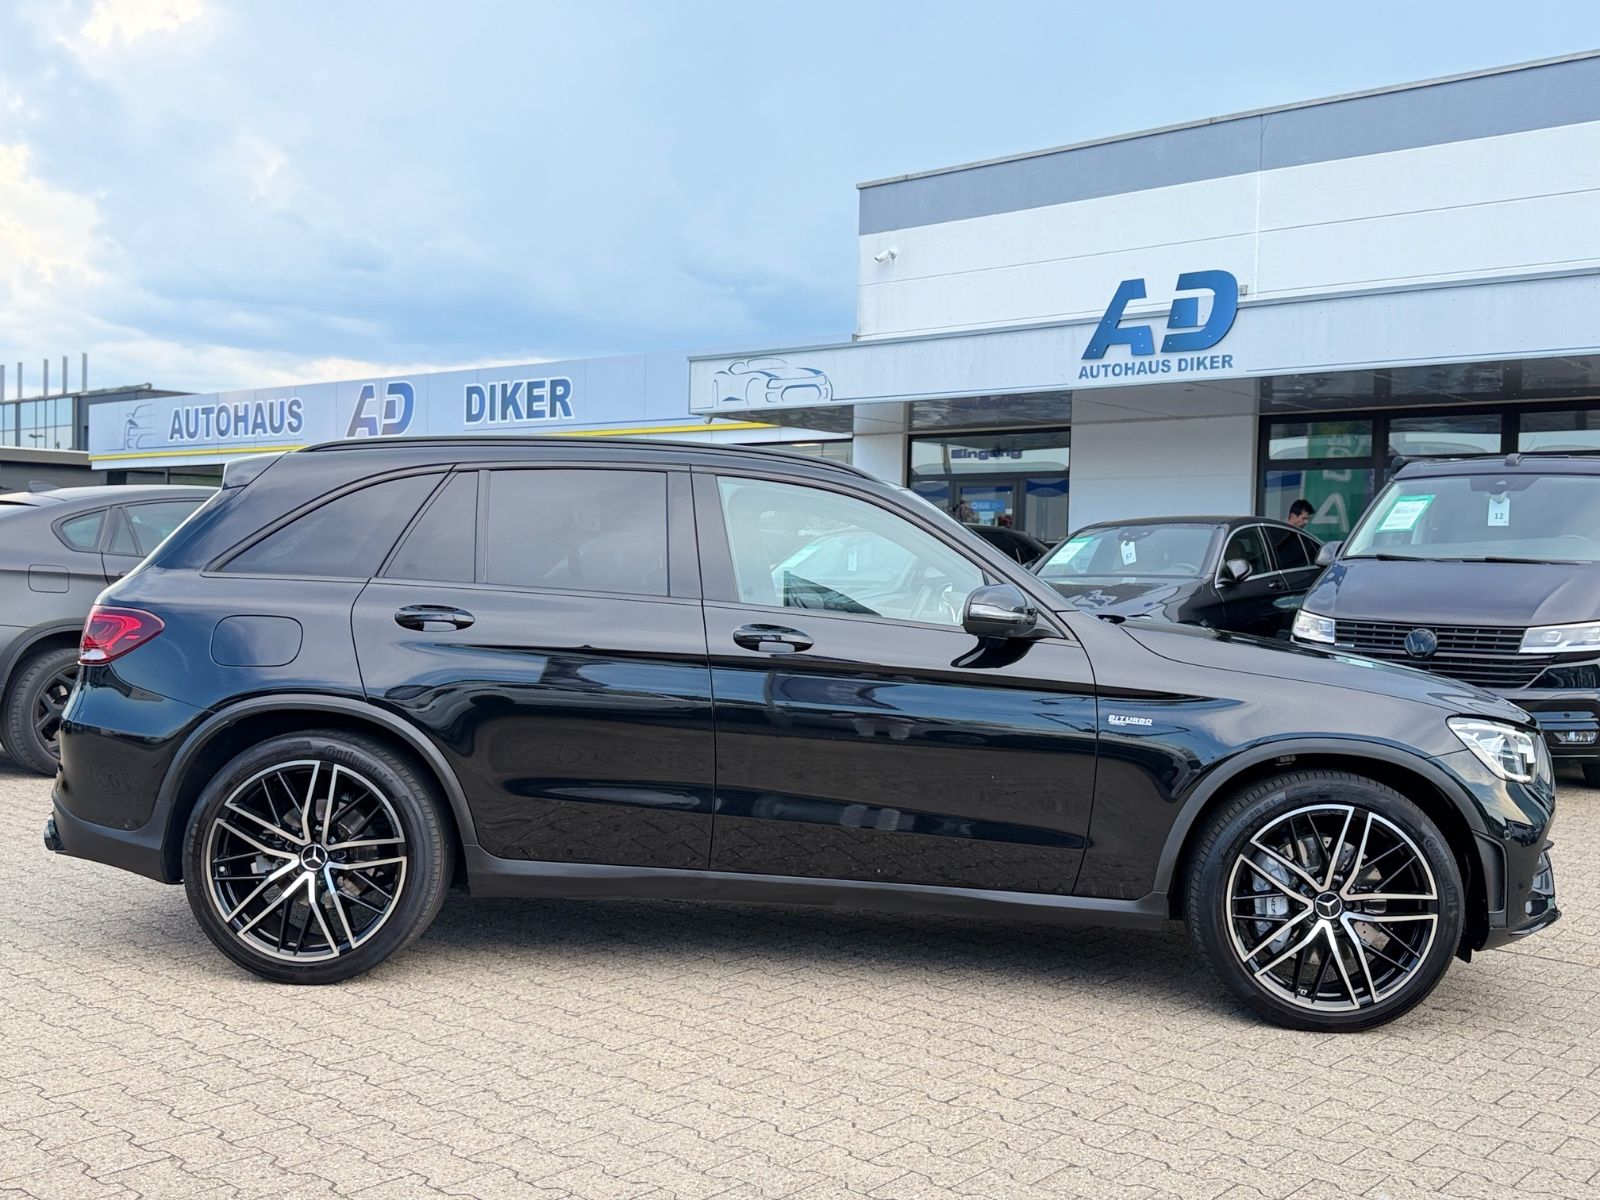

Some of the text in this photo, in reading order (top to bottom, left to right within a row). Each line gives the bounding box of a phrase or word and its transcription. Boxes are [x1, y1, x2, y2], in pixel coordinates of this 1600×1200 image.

[1081, 270, 1238, 360] AD
[1078, 354, 1233, 380] AUTOHAUS DIKER
[168, 377, 574, 441] AUTOHAUS AD DIKER
[1494, 512, 1504, 520] 12
[1108, 714, 1153, 726] BITURBO
